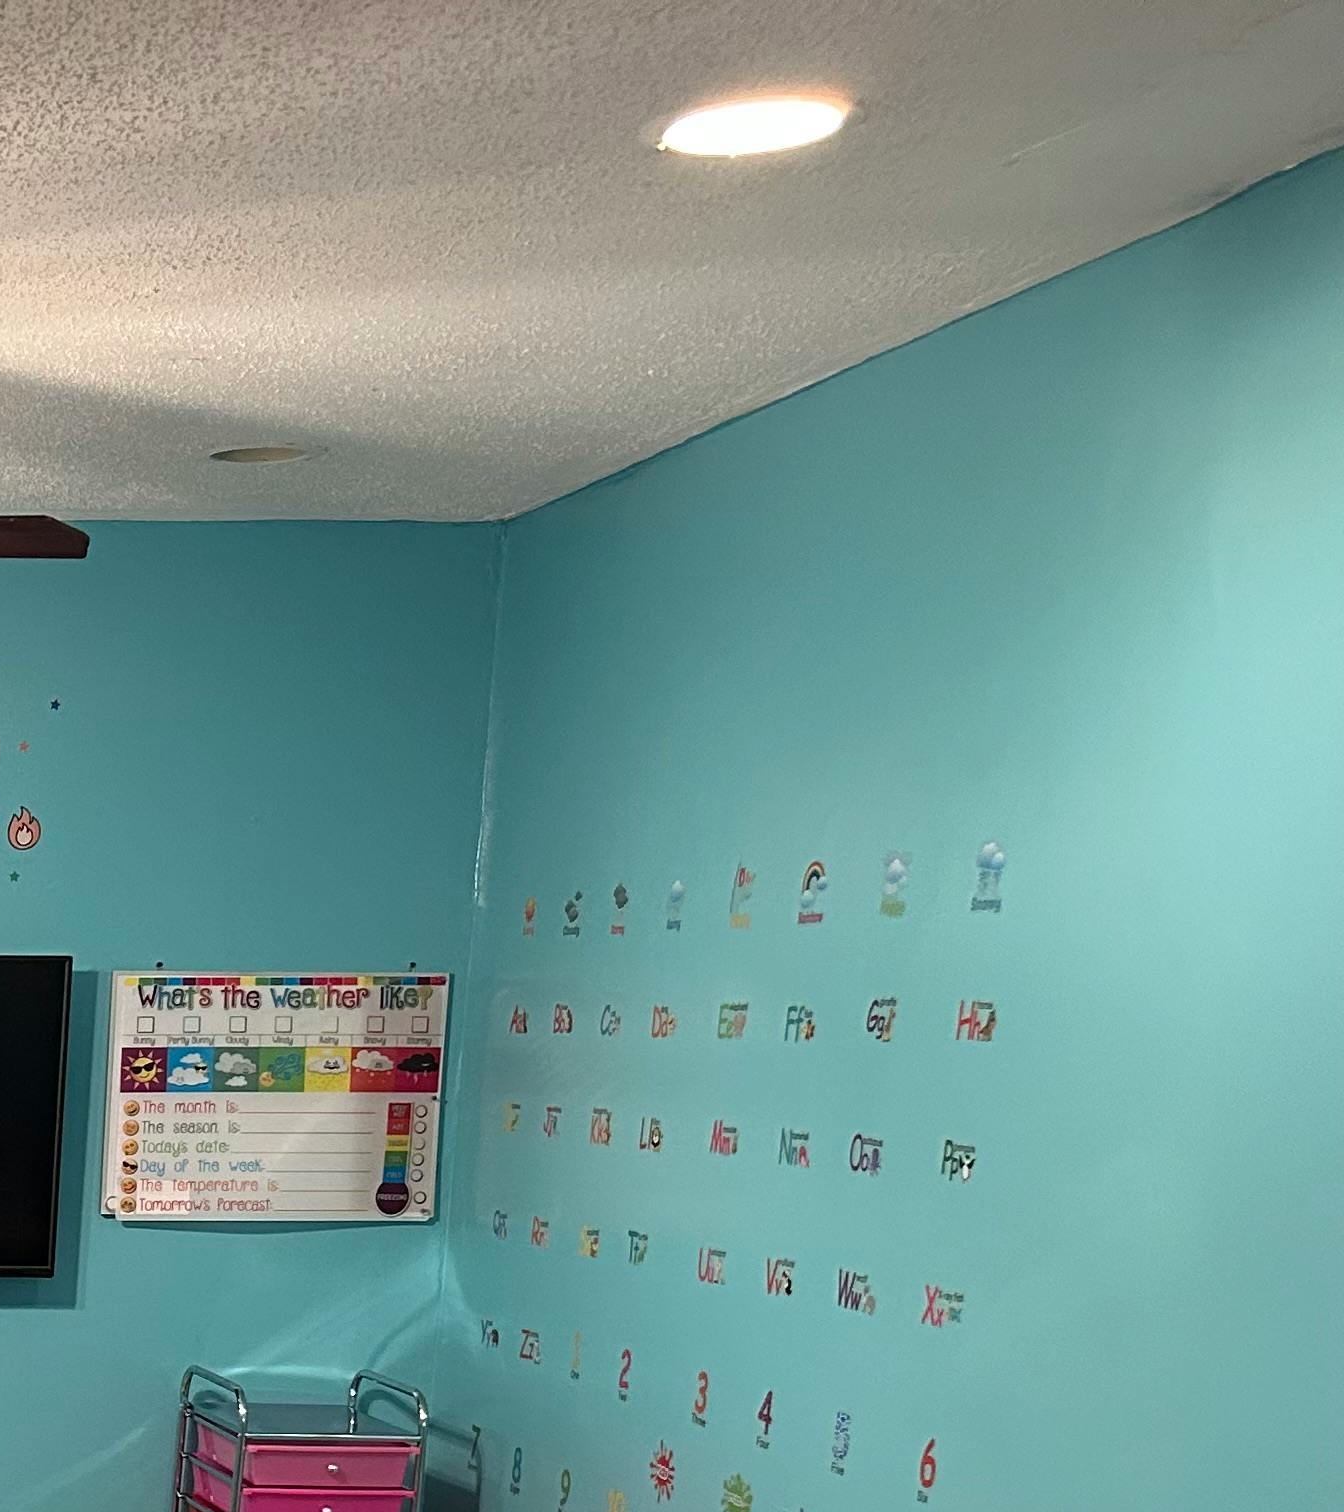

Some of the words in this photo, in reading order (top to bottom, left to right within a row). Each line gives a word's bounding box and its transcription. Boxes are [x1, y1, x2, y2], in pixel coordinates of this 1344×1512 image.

[221, 984, 260, 1011] the
[270, 984, 369, 1010] weather
[143, 1100, 165, 1114] The
[174, 1100, 217, 1114] month
[142, 1120, 165, 1134] The
[173, 1122, 219, 1134] season
[140, 1159, 165, 1177] Day
[174, 1159, 189, 1172] of
[198, 1159, 220, 1172] the
[140, 1178, 162, 1192] The
[172, 1179, 259, 1194] temperature
[619, 1349, 631, 1389] 2
[695, 1371, 708, 1414] 3
[758, 1390, 773, 1435] 4
[472, 1424, 481, 1459] 7
[512, 1447, 522, 1483] 8
[920, 1438, 936, 1488] 6
[560, 1469, 571, 1506] 9
